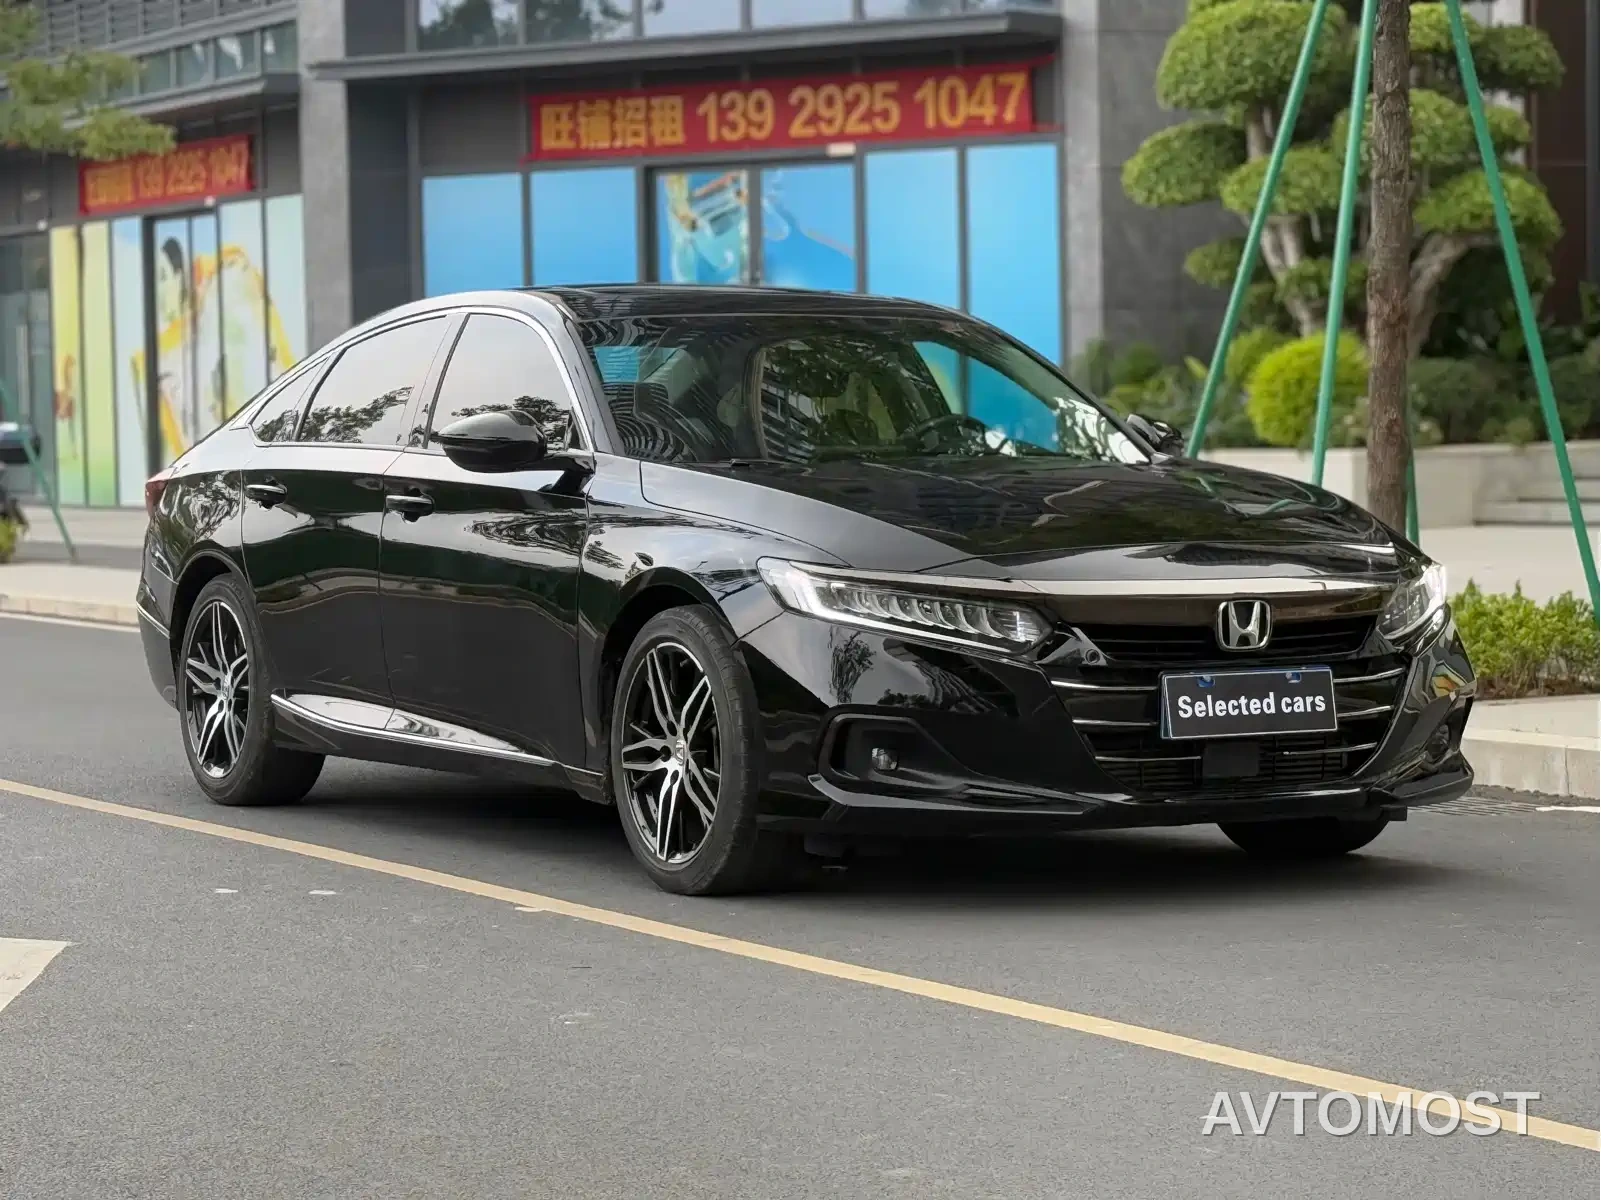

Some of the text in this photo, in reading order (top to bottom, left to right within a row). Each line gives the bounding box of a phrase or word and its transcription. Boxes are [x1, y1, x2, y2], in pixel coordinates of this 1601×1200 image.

[697, 88, 774, 142] 139
[788, 80, 900, 138] 2925
[913, 71, 1028, 129] 1047
[1177, 691, 1326, 719] Selected cars
